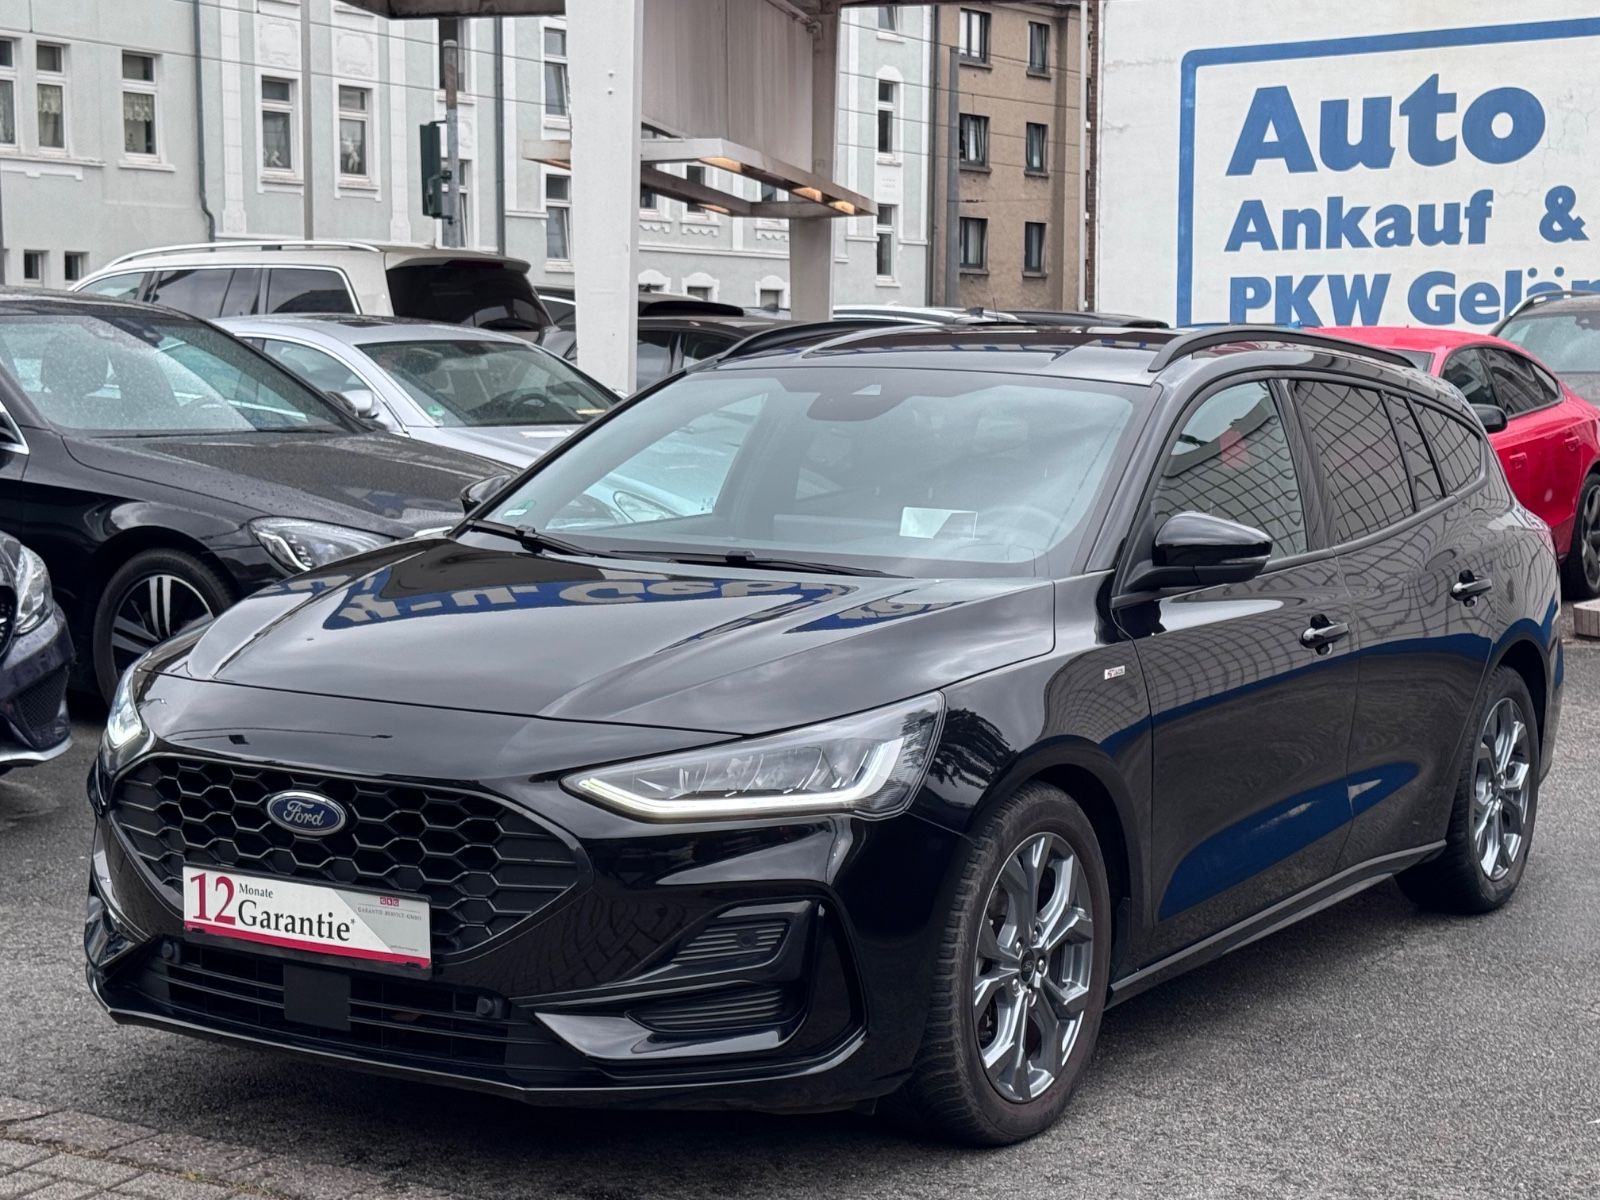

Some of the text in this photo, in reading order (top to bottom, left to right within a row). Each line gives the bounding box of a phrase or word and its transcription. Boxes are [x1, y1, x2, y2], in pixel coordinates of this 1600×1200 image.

[1225, 73, 1546, 177] Auto
[1224, 185, 1590, 252] Ankauf &
[1230, 267, 1600, 327] PKW Gel
[283, 801, 324, 827] Ford
[190, 872, 236, 926] 12
[239, 883, 274, 899] Monate
